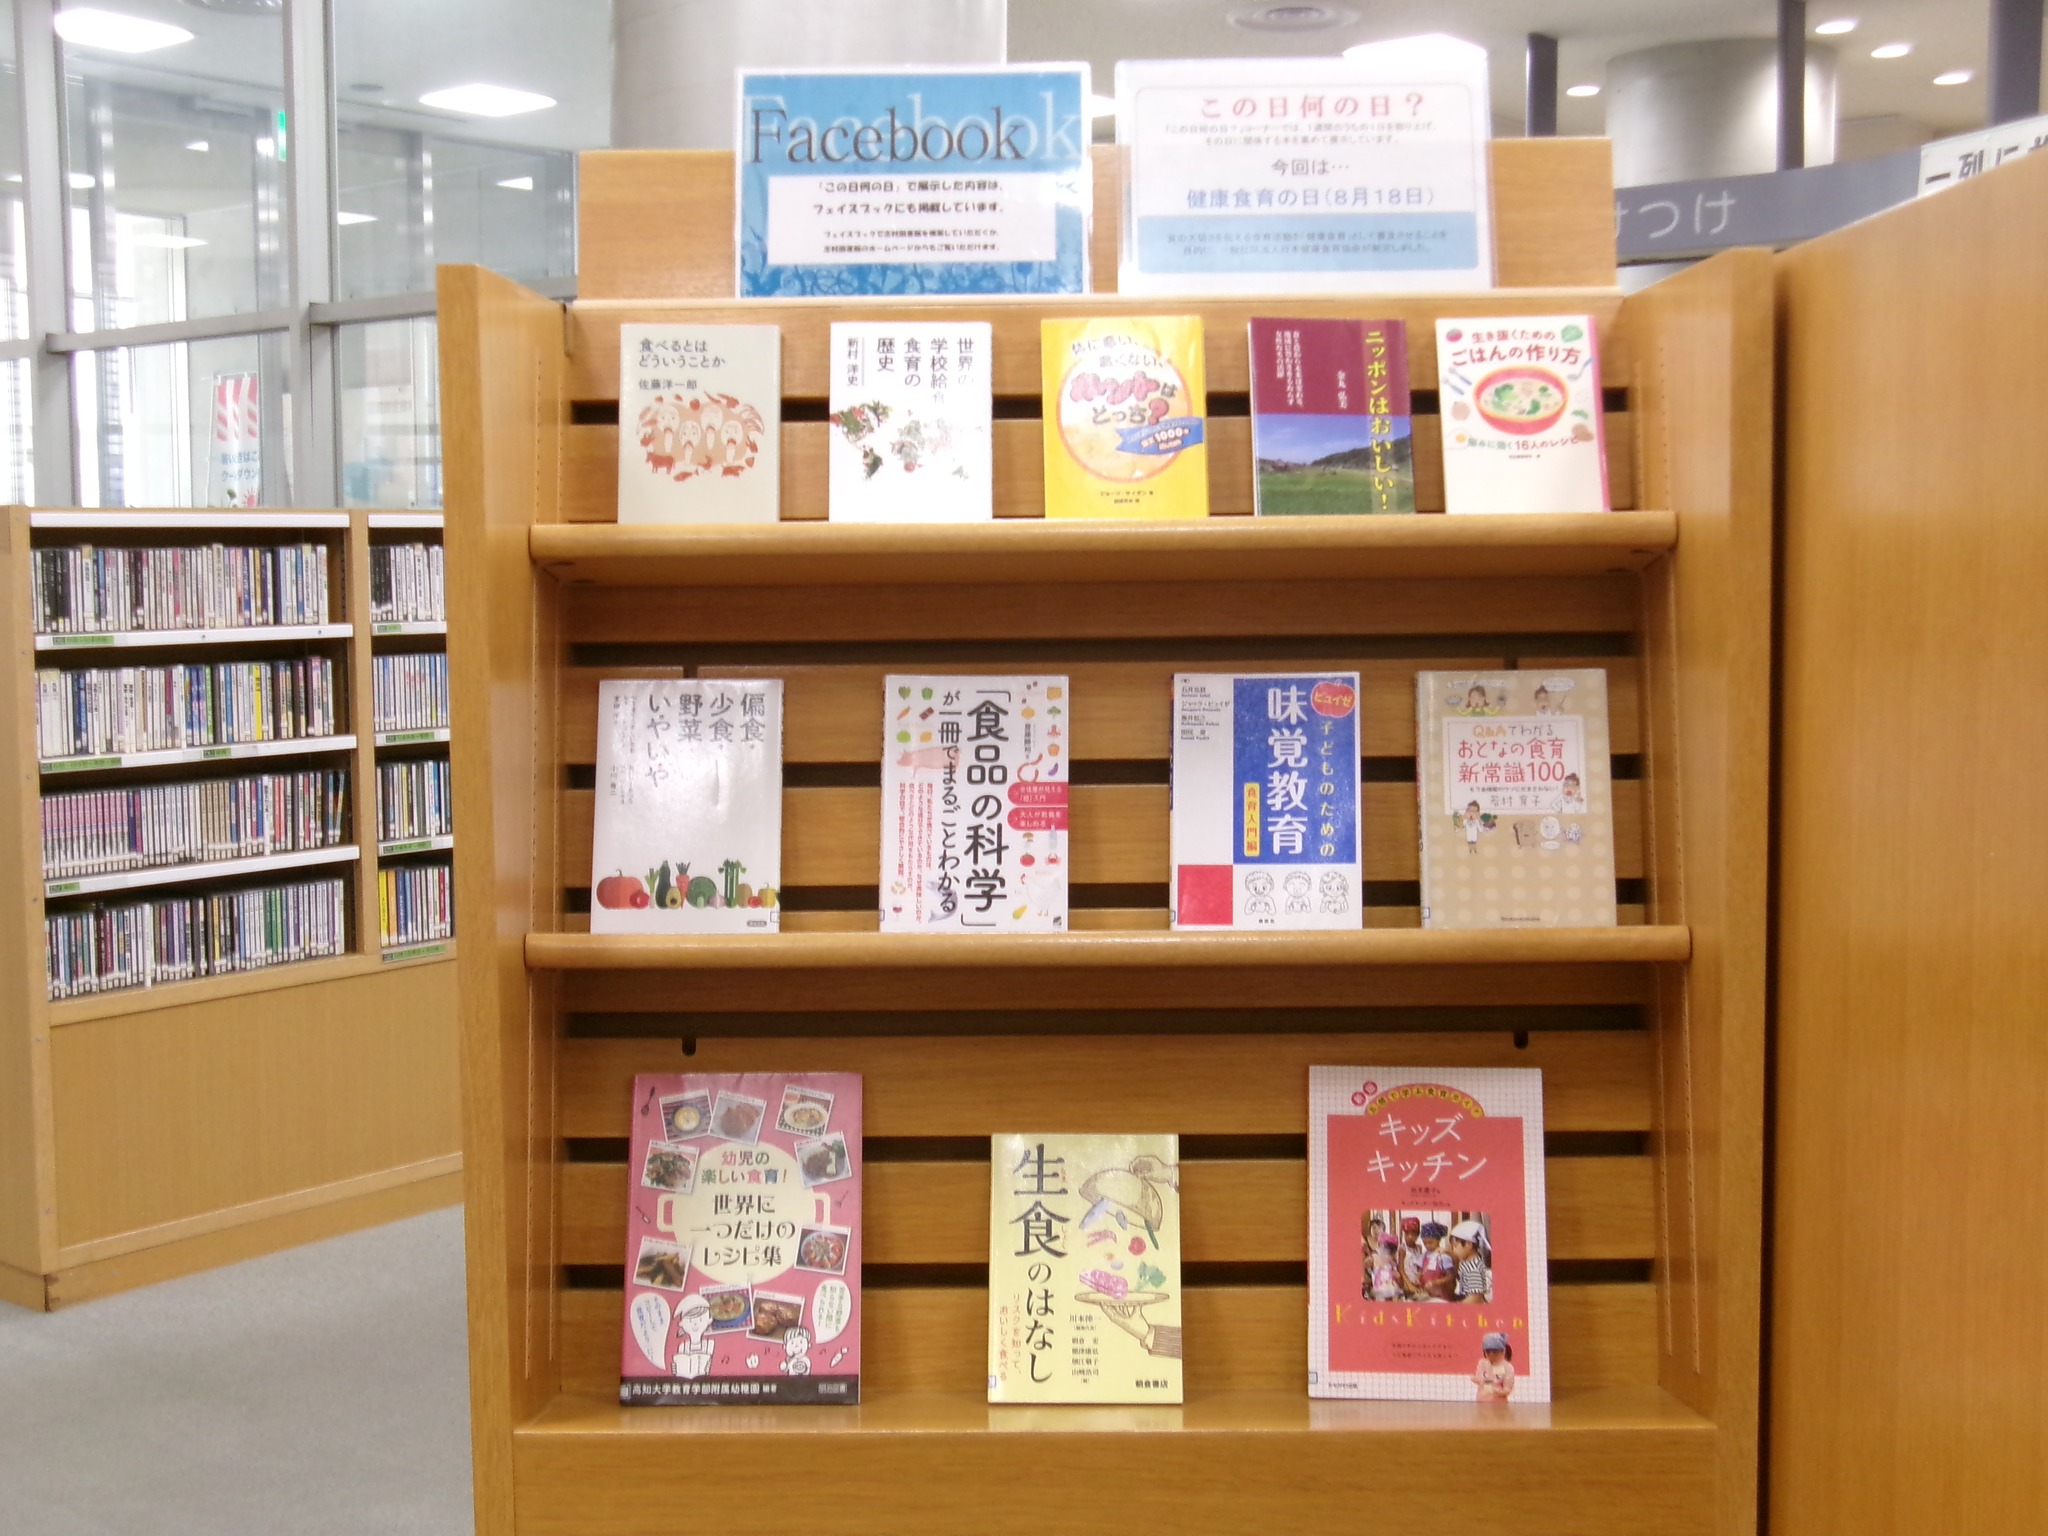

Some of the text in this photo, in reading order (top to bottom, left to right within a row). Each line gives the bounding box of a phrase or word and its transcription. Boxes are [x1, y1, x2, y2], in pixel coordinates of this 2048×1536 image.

[751, 105, 1025, 163] Facebook
[639, 338, 708, 353] 食べるとは
[1472, 329, 1555, 343] 生き抜くための
[638, 354, 726, 369] どういうことか
[877, 337, 896, 372] 歴史
[904, 337, 922, 387] 食育の
[1452, 344, 1581, 366] ごはんの作り方
[639, 378, 698, 390] 佐藤洋一郎
[1314, 691, 1353, 708] ピュイゼ
[645, 693, 671, 787] いやいや
[1457, 737, 1566, 760] おとなの食育
[1267, 685, 1309, 855] 味覚教育
[1458, 761, 1566, 784] 新常識100
[937, 690, 963, 914] が一冊でまるごとわかる
[1319, 721, 1335, 857] 子どものための
[960, 690, 1011, 926] 「食品の科学」
[1378, 1112, 1464, 1146] キッズ
[721, 1151, 770, 1166] 幼児の
[1367, 1150, 1487, 1183] キッチン
[701, 1169, 788, 1185] 楽しい食育！
[713, 1194, 776, 1216] 世界に
[690, 1220, 796, 1241] 一つだけの
[703, 1245, 782, 1268] レシピ集
[1009, 1143, 1071, 1384] 生食のはなし
[999, 1305, 1008, 1381] おいしく食べる
[1012, 1294, 1022, 1374] リスクを知って、
